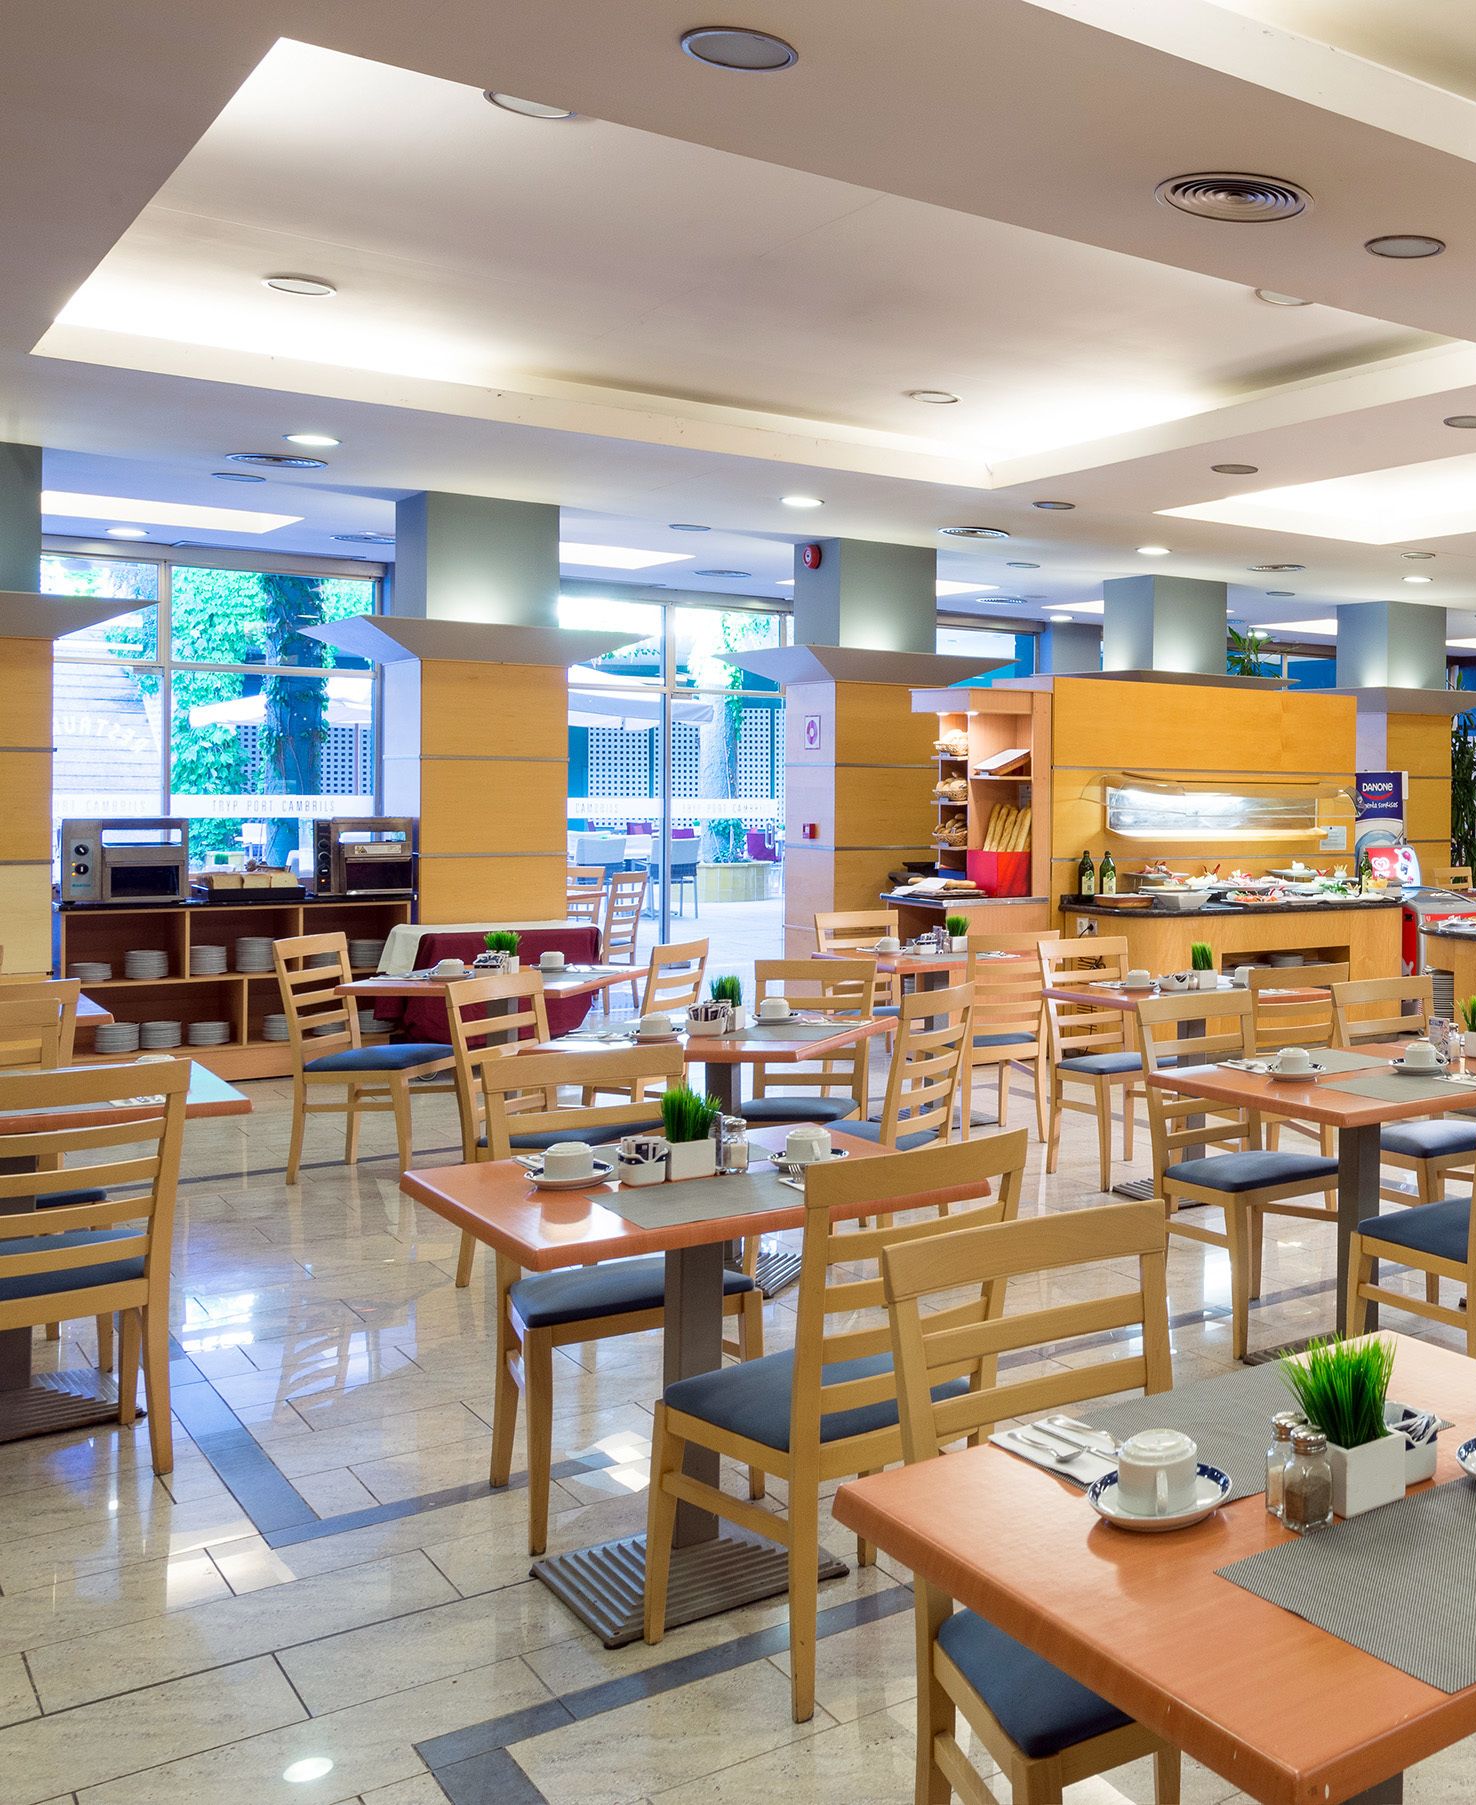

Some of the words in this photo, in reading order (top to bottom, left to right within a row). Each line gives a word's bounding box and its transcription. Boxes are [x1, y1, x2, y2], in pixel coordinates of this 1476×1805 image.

[212, 799, 238, 812] TRYP
[247, 799, 273, 812] PORT
[281, 799, 335, 812] CAMBRILS
